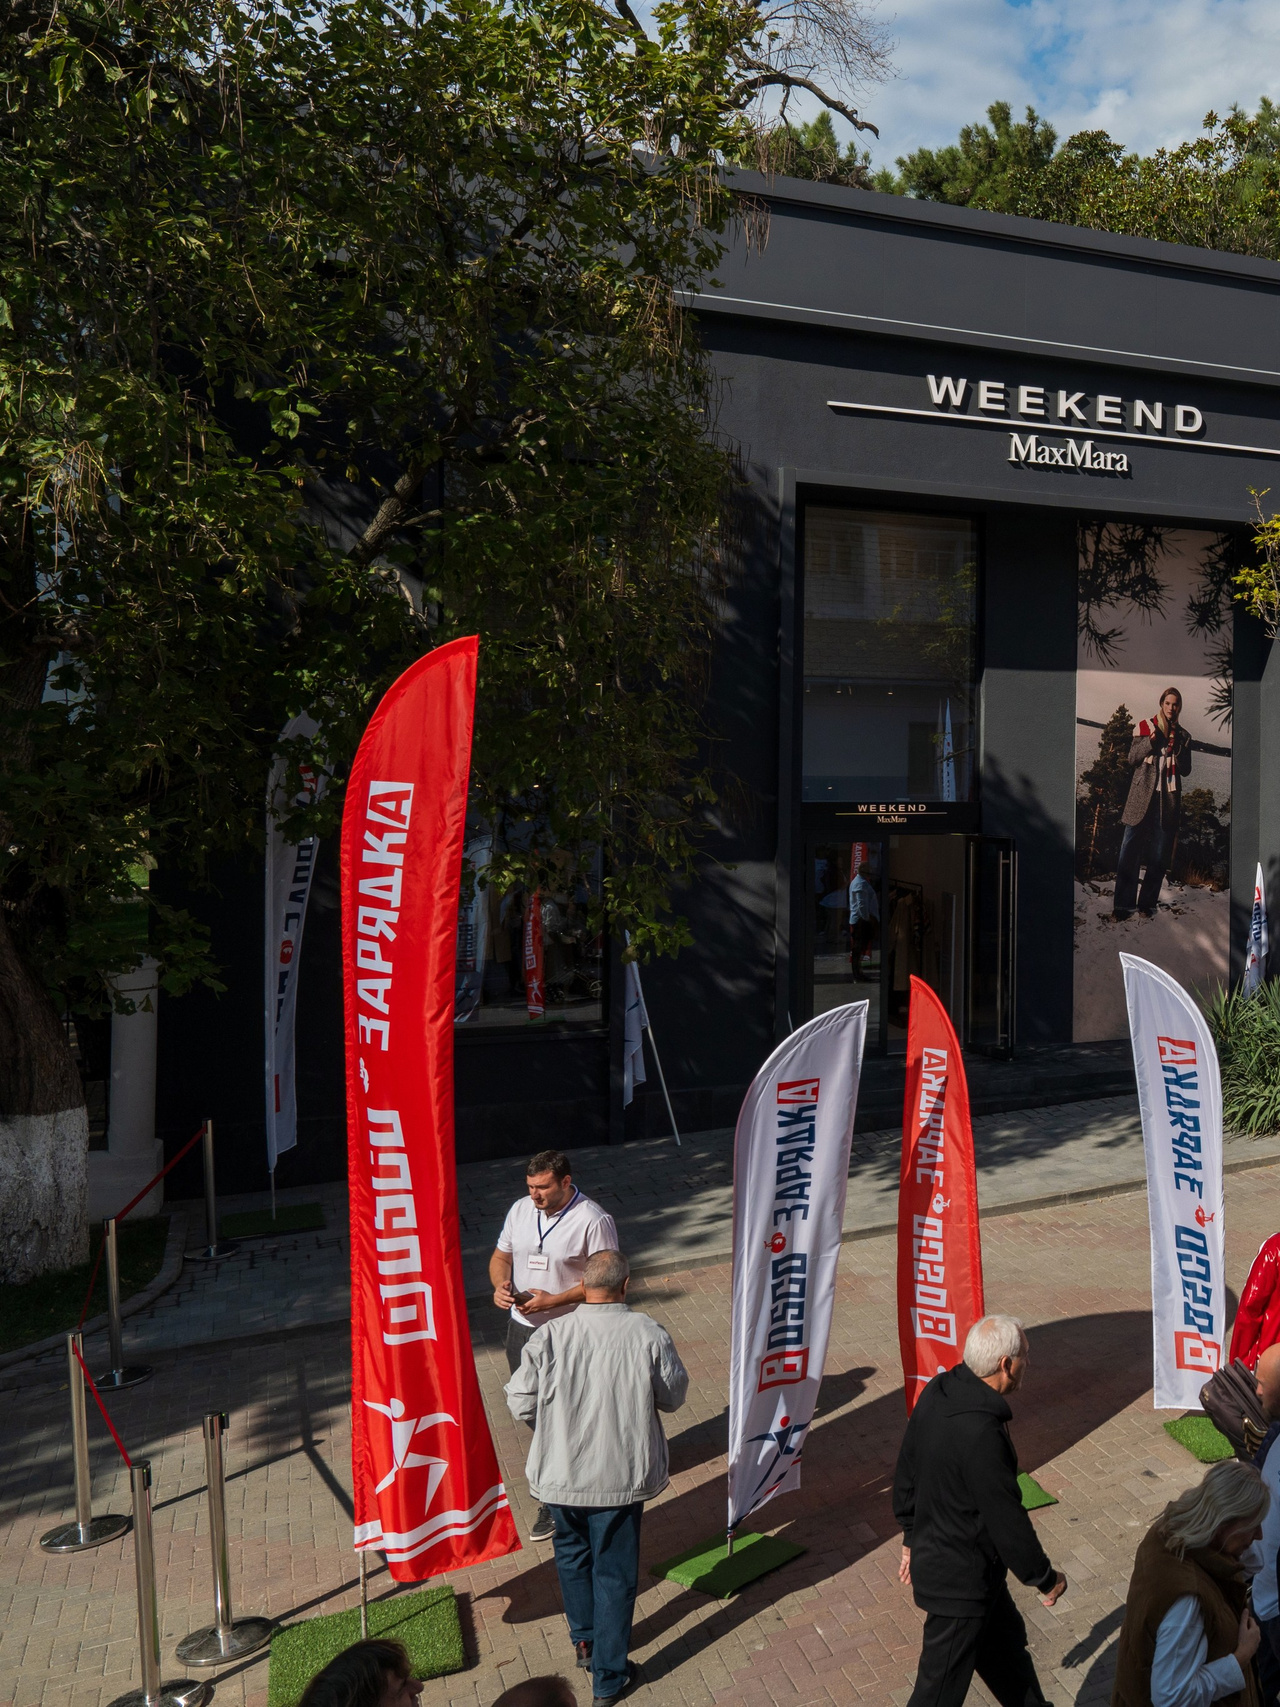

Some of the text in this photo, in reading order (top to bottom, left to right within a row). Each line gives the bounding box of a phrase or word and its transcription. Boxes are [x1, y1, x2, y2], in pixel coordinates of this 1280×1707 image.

[926, 374, 1204, 433] WEEKEND
[1006, 432, 1129, 473] MaxMara
[857, 804, 928, 812] WEEKEND
[877, 815, 907, 823] MaxMara
[356, 780, 437, 1345] BOSCO ЗАРЯДКА
[757, 1077, 820, 1393] BOSCO ЗАРЯДКА
